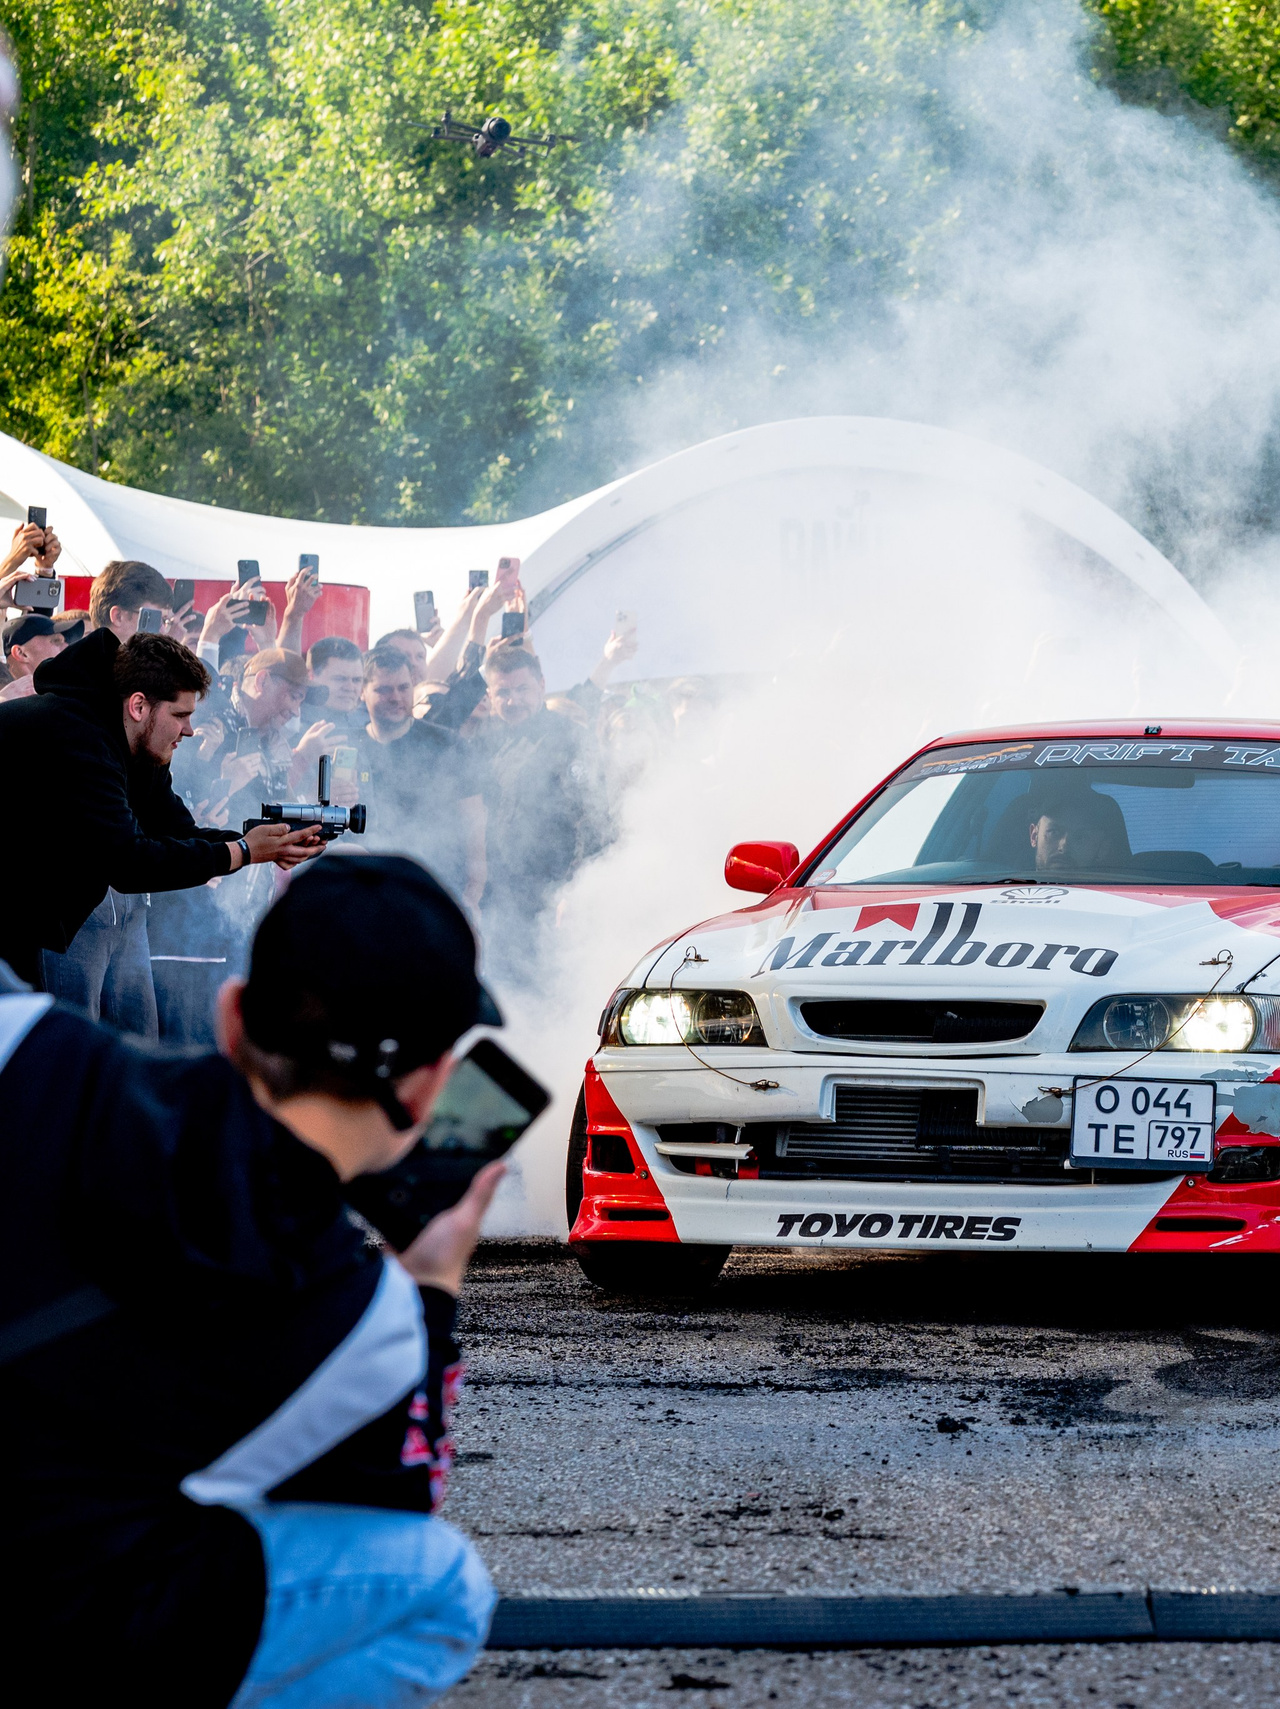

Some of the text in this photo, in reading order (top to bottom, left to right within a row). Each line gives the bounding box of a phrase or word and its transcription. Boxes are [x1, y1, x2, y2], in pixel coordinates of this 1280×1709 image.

[1034, 743, 1213, 766] DRIFT
[751, 902, 1119, 978] Marlboro
[1132, 1086, 1192, 1118] 044
[1155, 1125, 1201, 1149] 797
[1167, 1150, 1189, 1158] RUS
[776, 1213, 1022, 1241] TOYO TIRES
